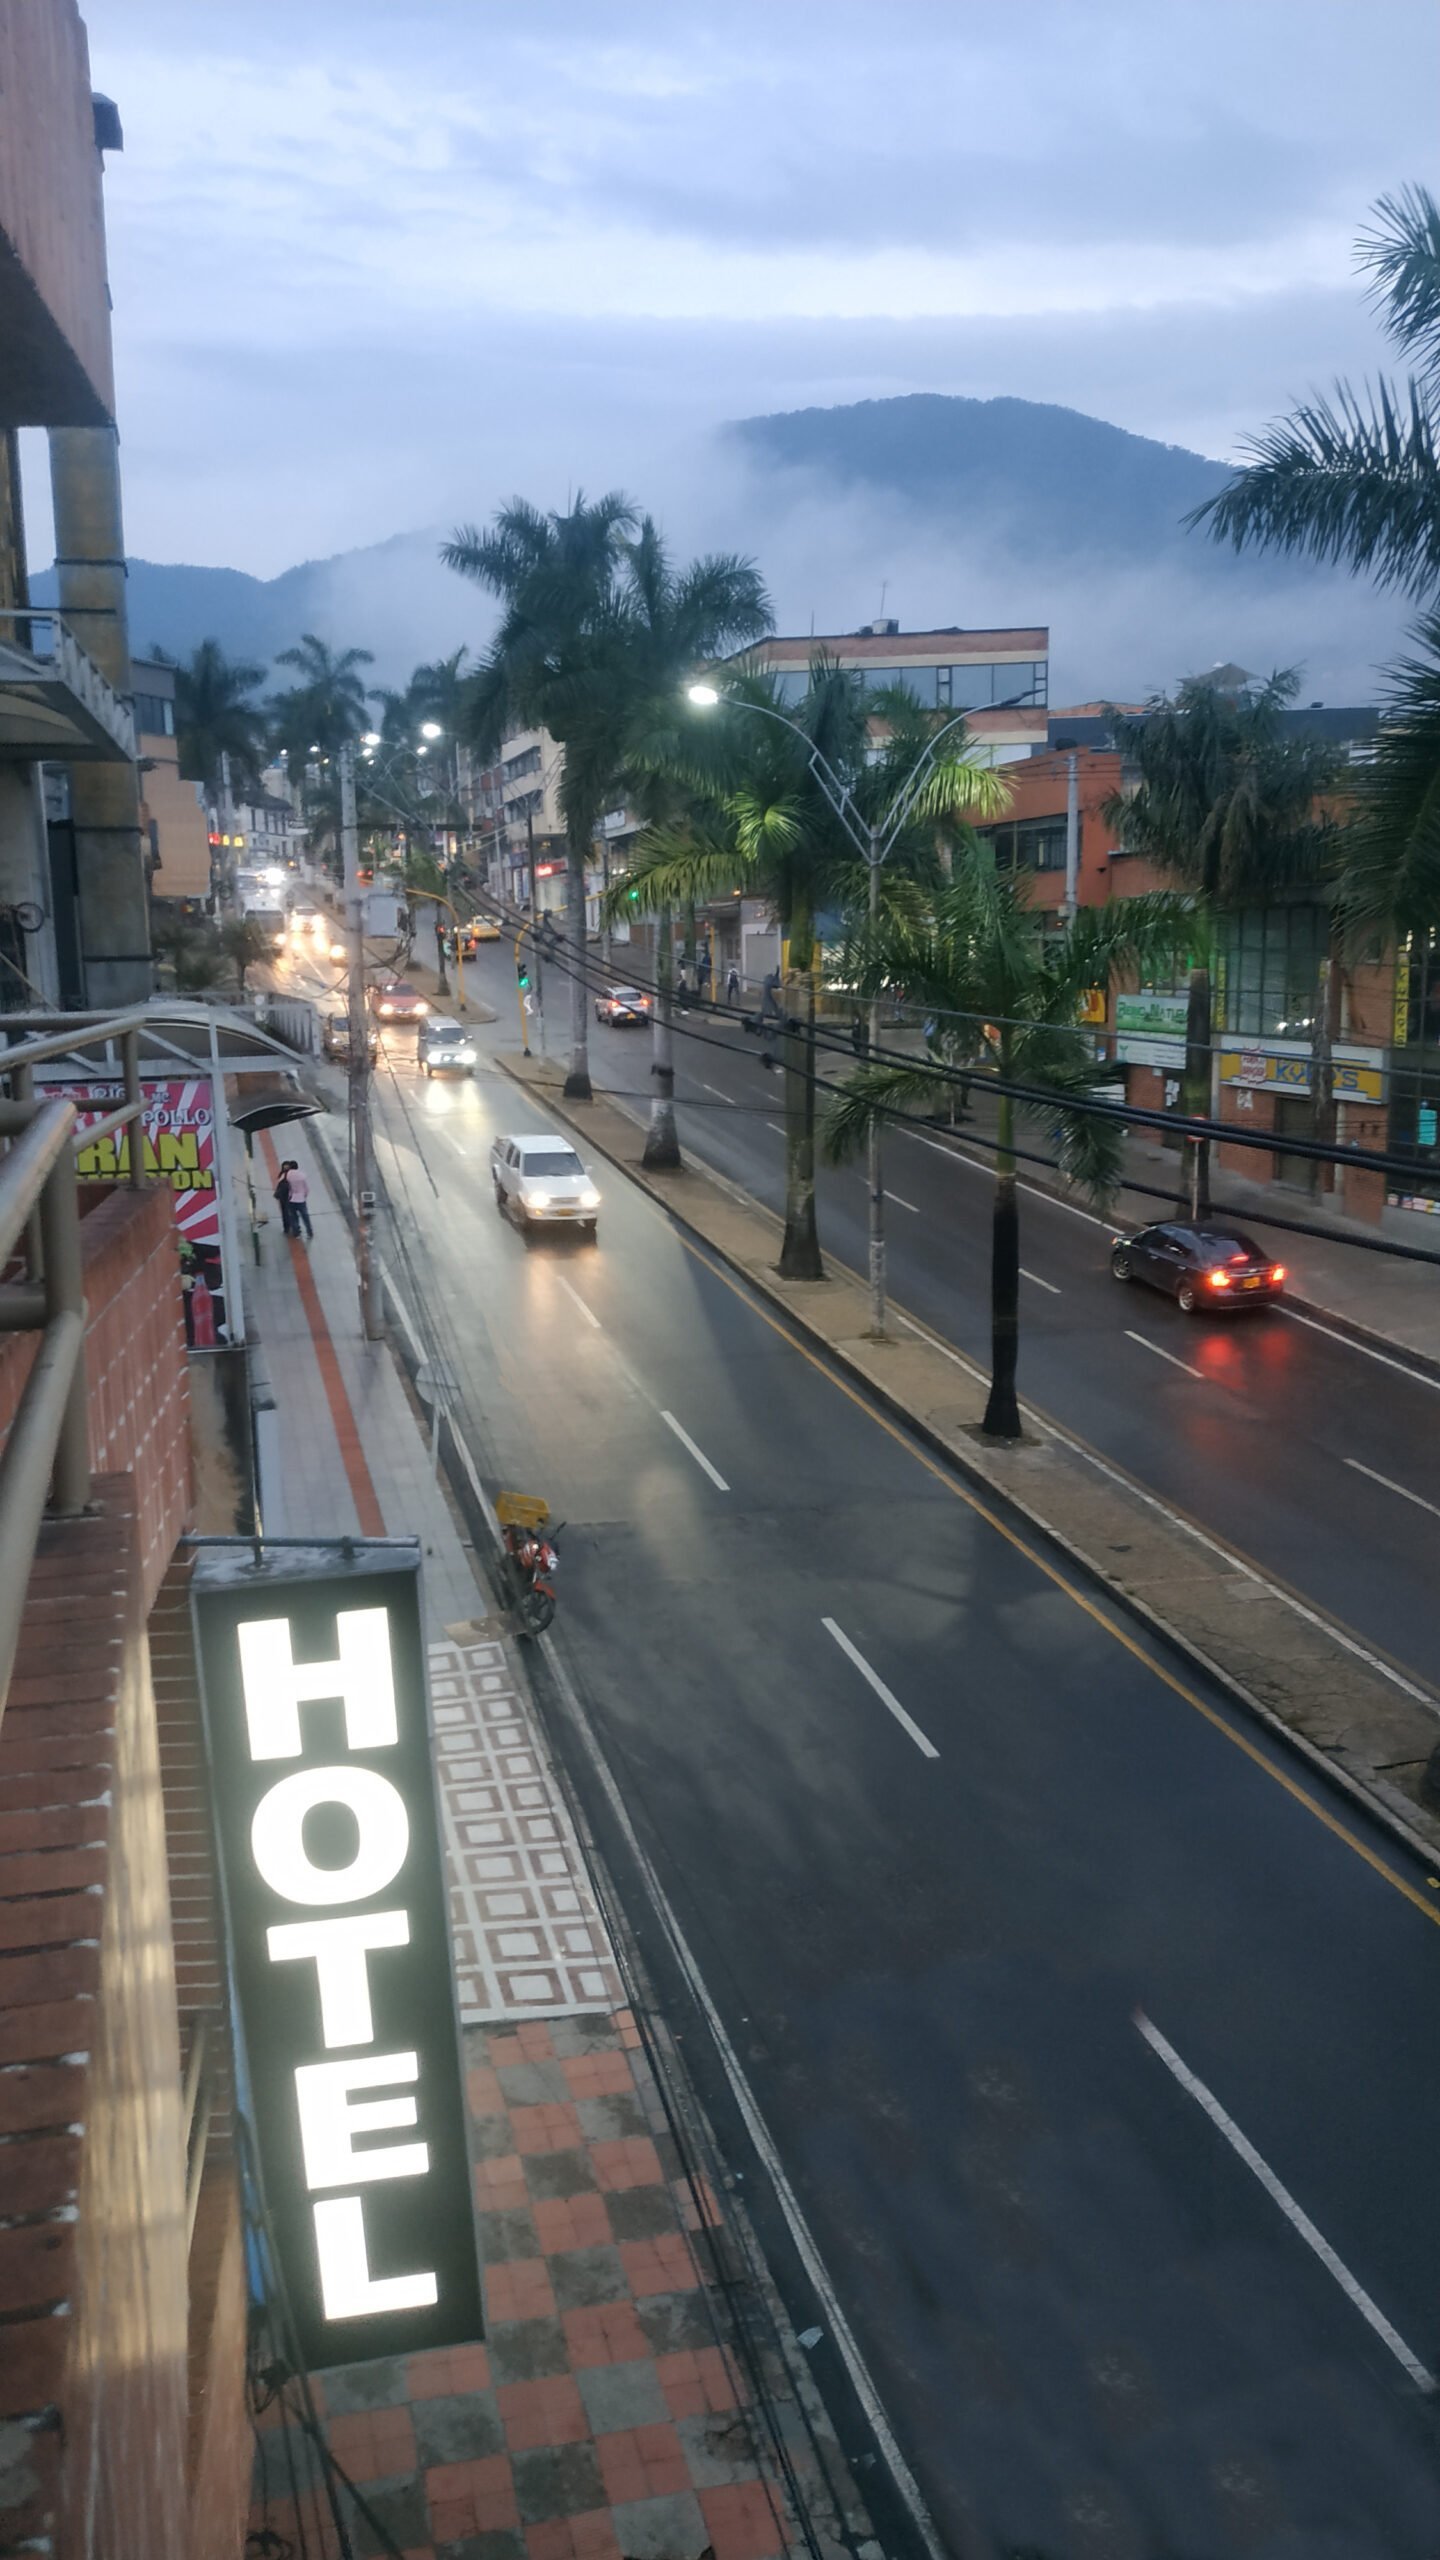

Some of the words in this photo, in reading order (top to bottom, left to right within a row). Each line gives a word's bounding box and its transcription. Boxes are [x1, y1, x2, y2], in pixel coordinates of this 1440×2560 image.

[142, 1107, 211, 1127] POLLO
[77, 1132, 199, 1173] RAN
[238, 1608, 438, 2320] HOTEL
